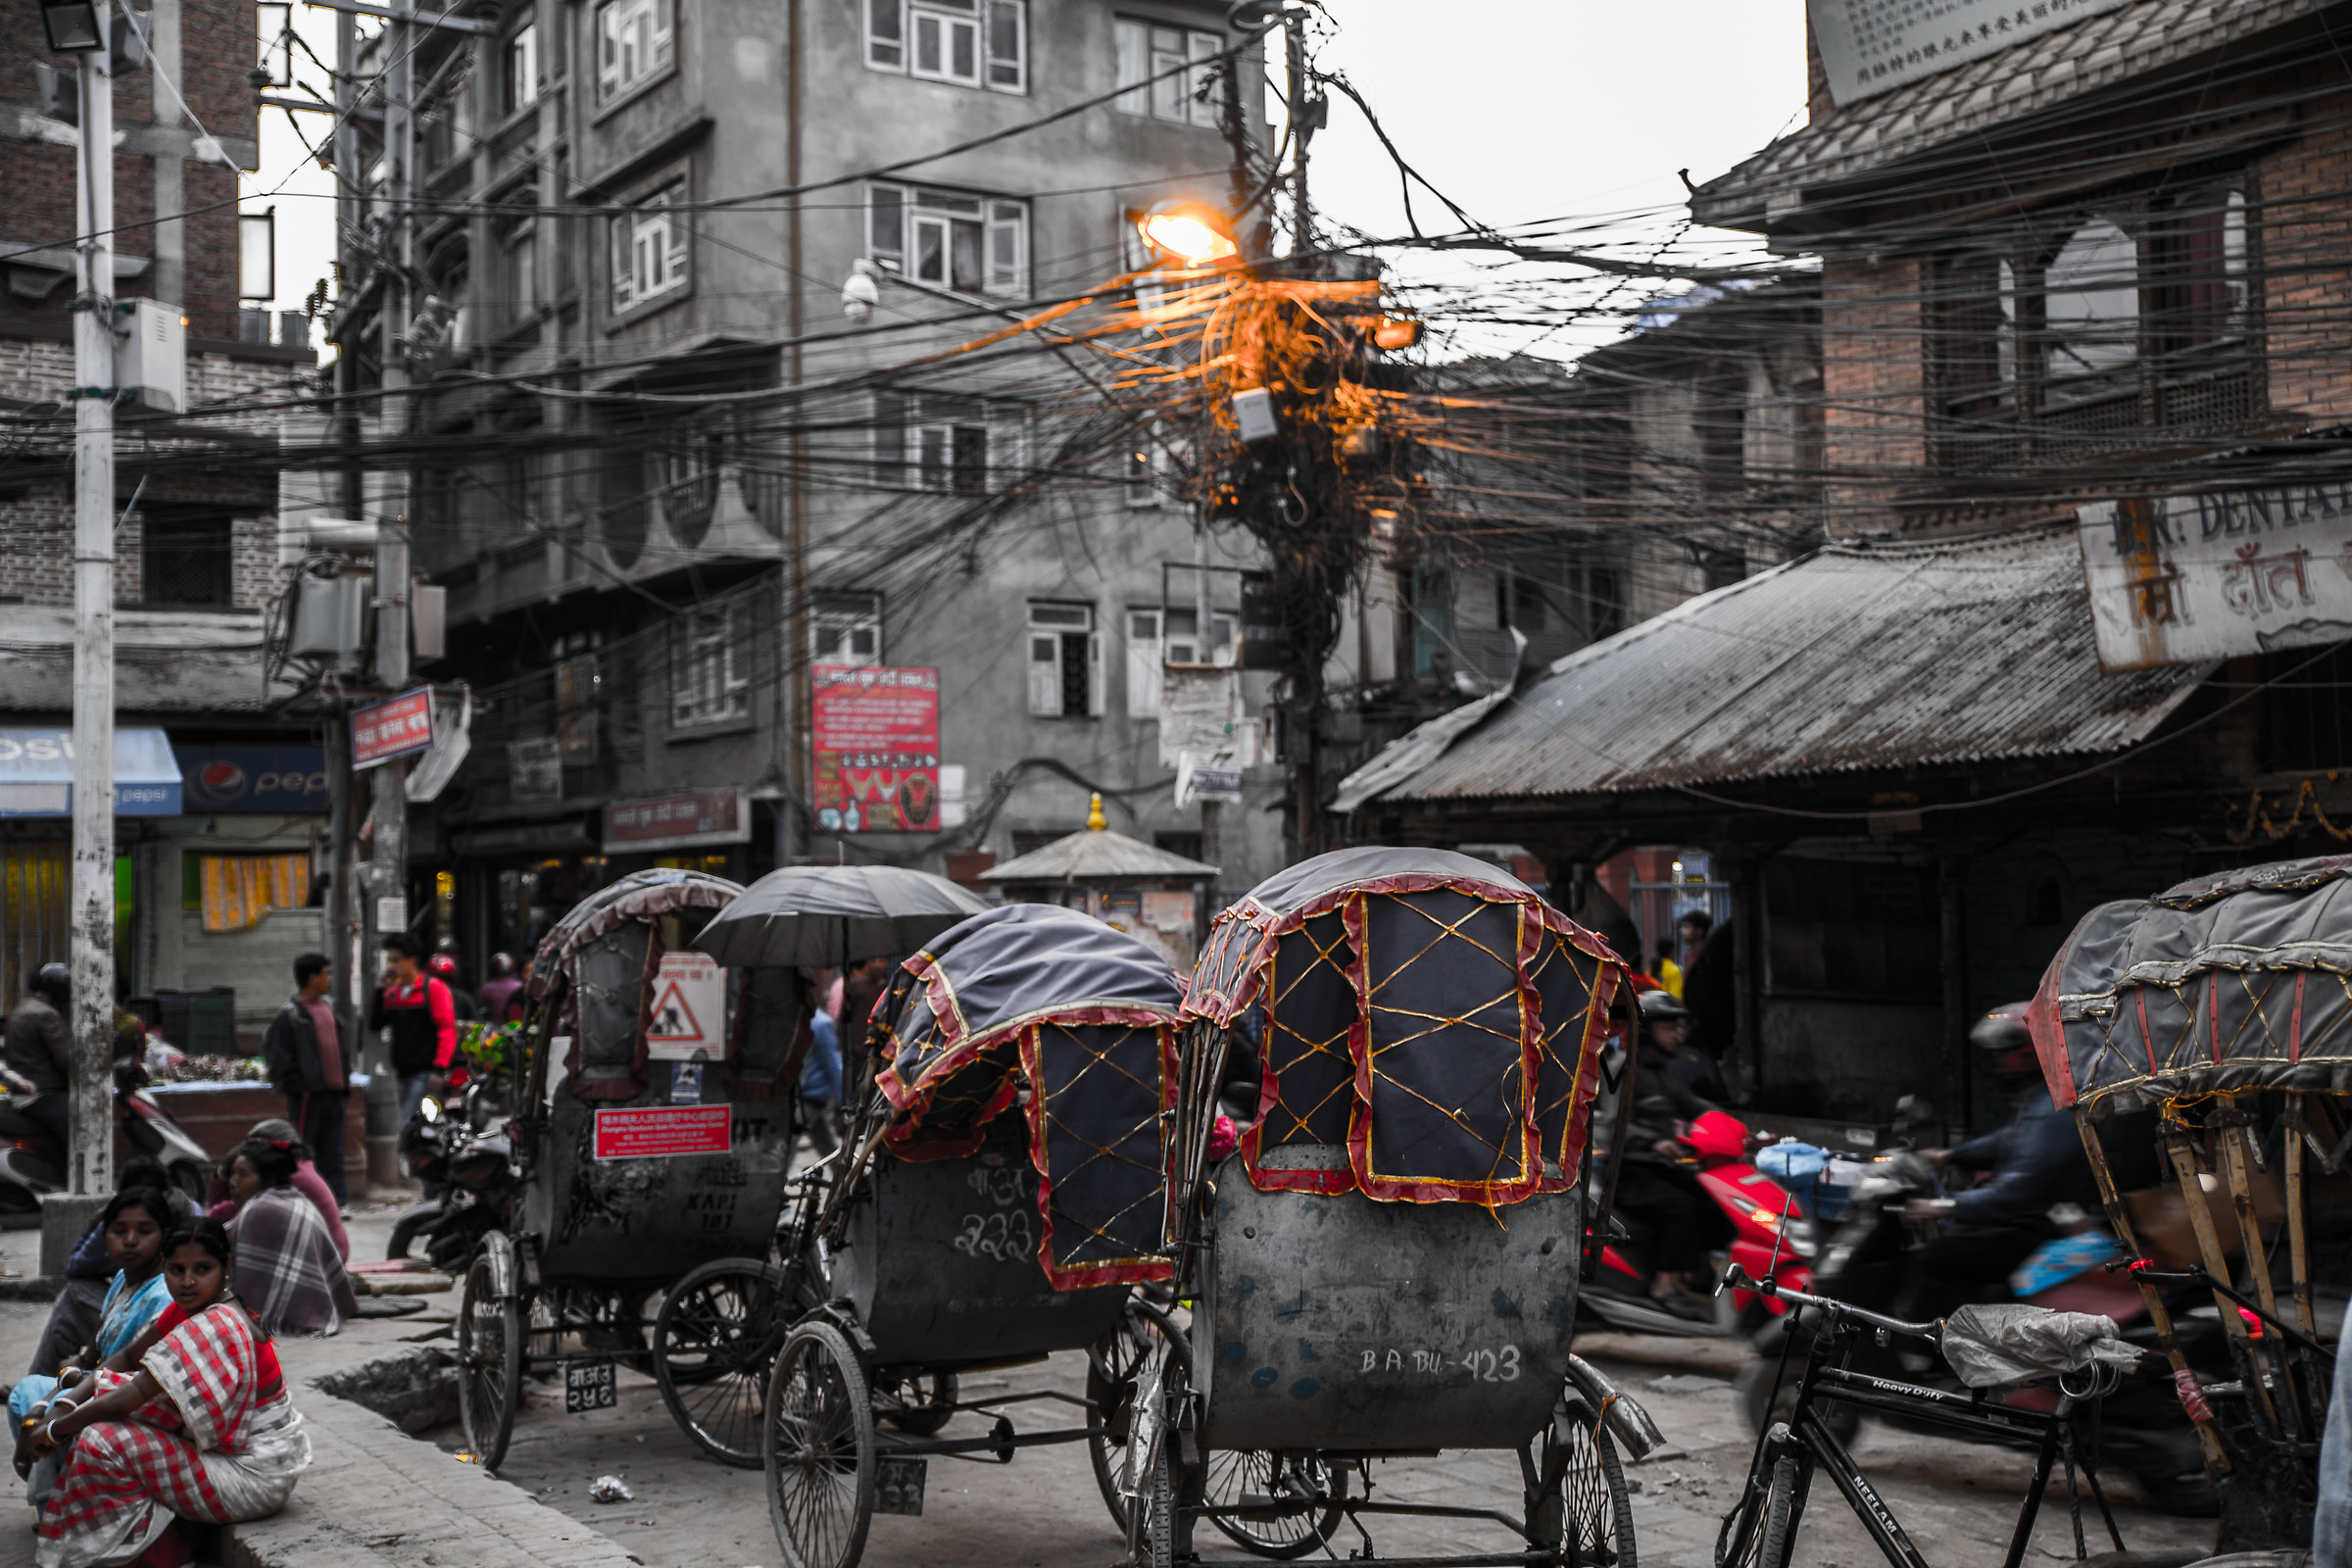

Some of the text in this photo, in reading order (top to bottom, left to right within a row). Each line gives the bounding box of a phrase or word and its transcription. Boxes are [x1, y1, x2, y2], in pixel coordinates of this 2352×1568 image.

[122, 787, 167, 804] pepsi
[1873, 1380, 1943, 1401] Heavy Duty
[1854, 1475, 1897, 1534] NEELAM
